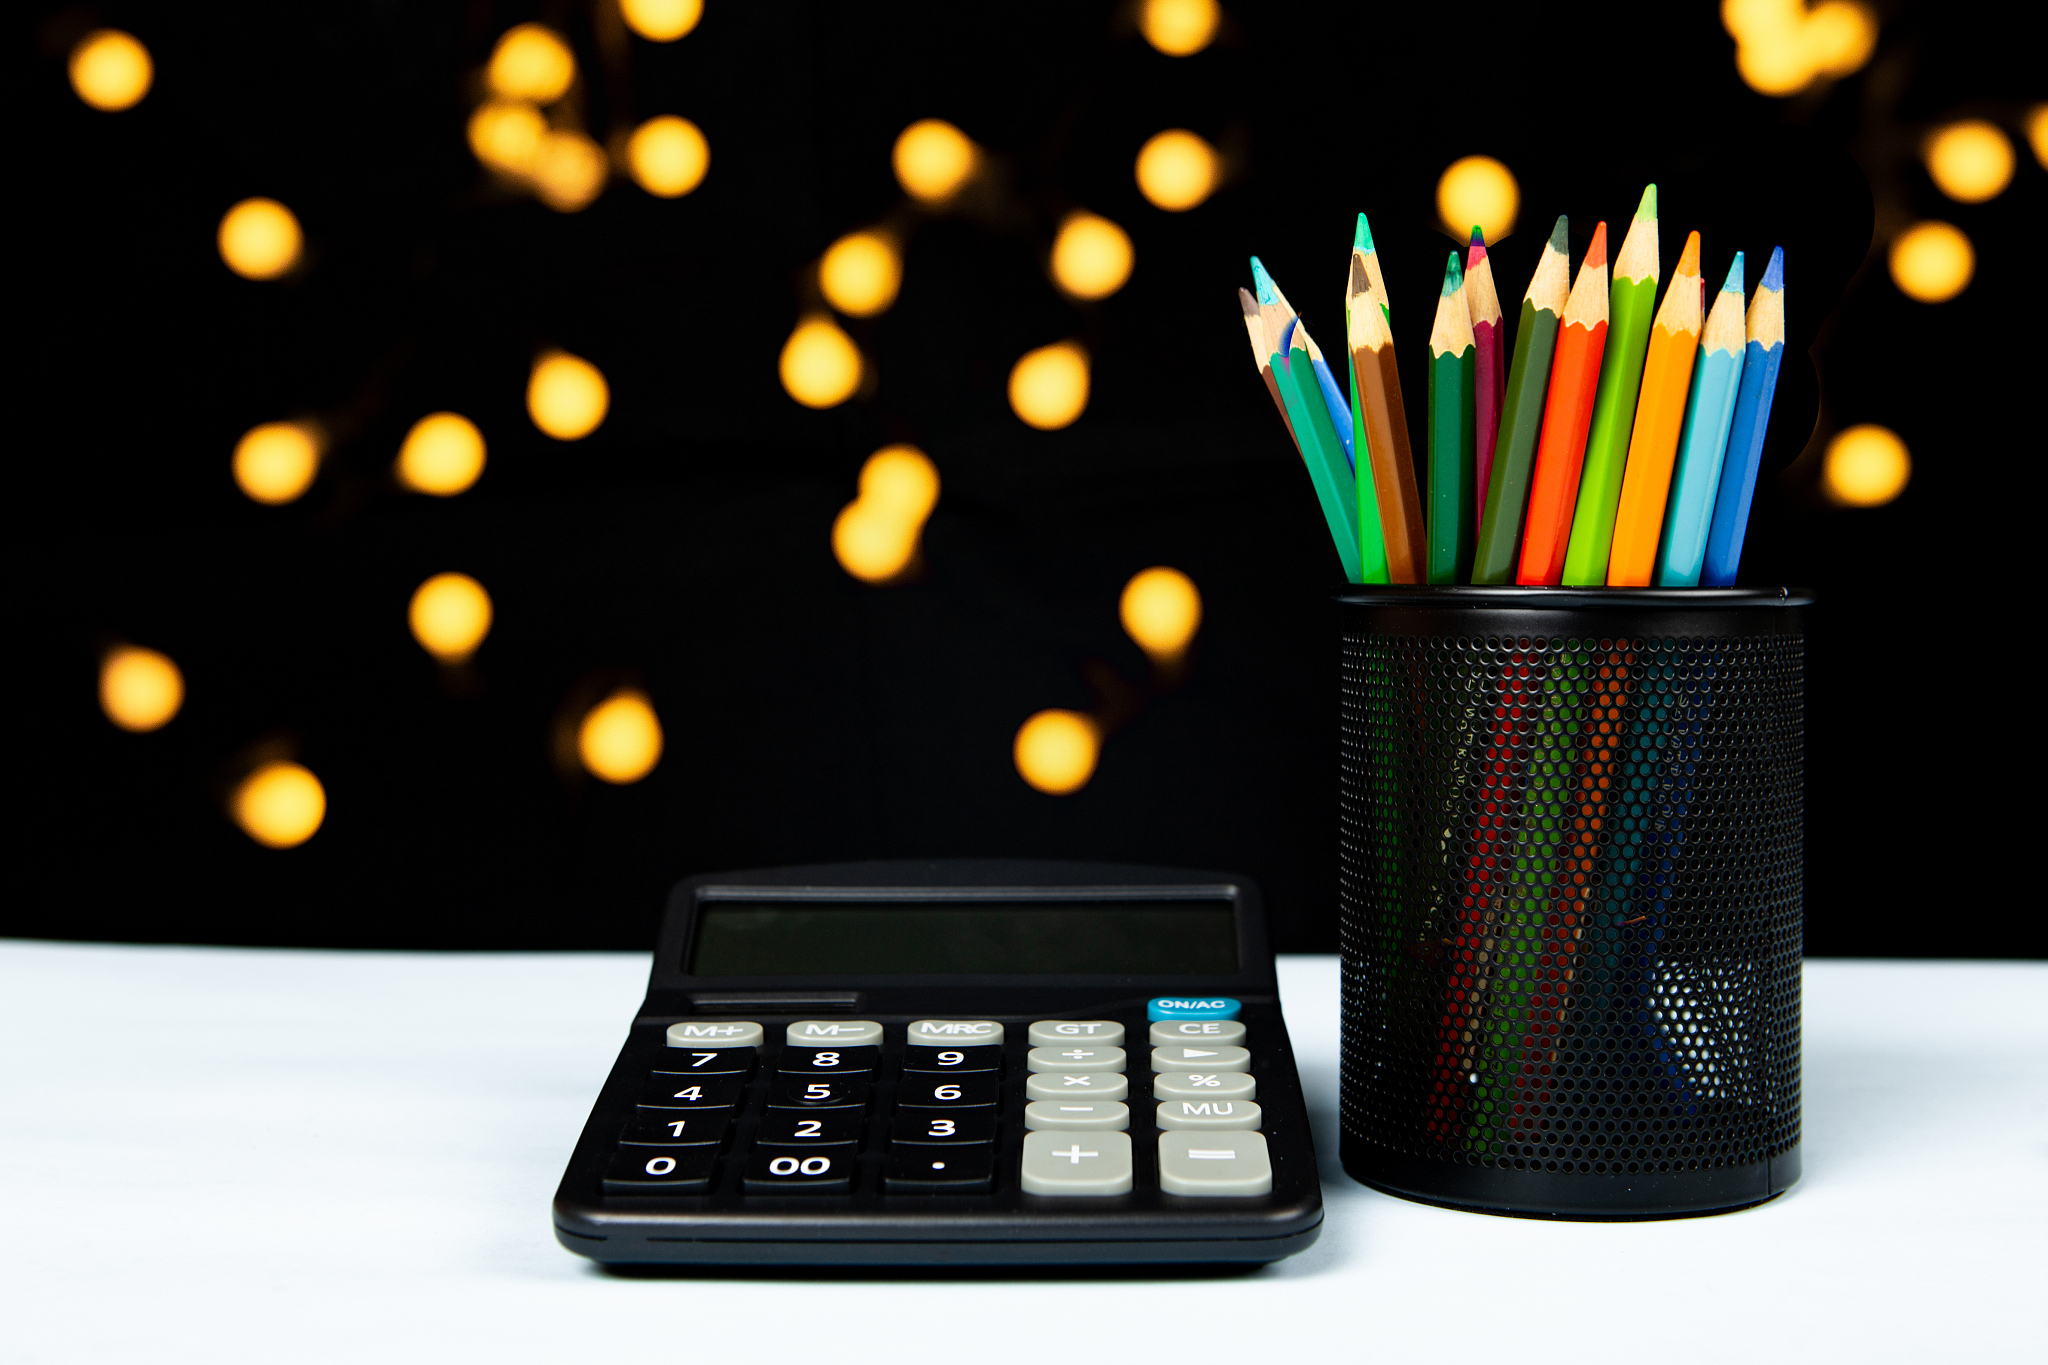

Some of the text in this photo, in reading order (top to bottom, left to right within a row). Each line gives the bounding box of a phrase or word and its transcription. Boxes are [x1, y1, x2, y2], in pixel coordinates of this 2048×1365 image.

[1158, 999, 1225, 1010] ON/AC
[684, 1025, 744, 1037] M+
[919, 1022, 991, 1035] MRC
[1055, 1023, 1097, 1035] GT
[1179, 1023, 1220, 1035] CE
[692, 1052, 718, 1067] 7
[812, 1051, 839, 1067] 8
[937, 1051, 964, 1066] 9
[1189, 1074, 1221, 1087] %
[674, 1086, 702, 1102] 4
[804, 1083, 831, 1100] 5
[934, 1084, 962, 1100] 6
[1182, 1102, 1233, 1116] MU
[667, 1120, 686, 1136] 1
[794, 1120, 822, 1137] 2
[928, 1119, 956, 1136] 3
[645, 1156, 677, 1175] 0
[769, 1156, 831, 1175] 00
